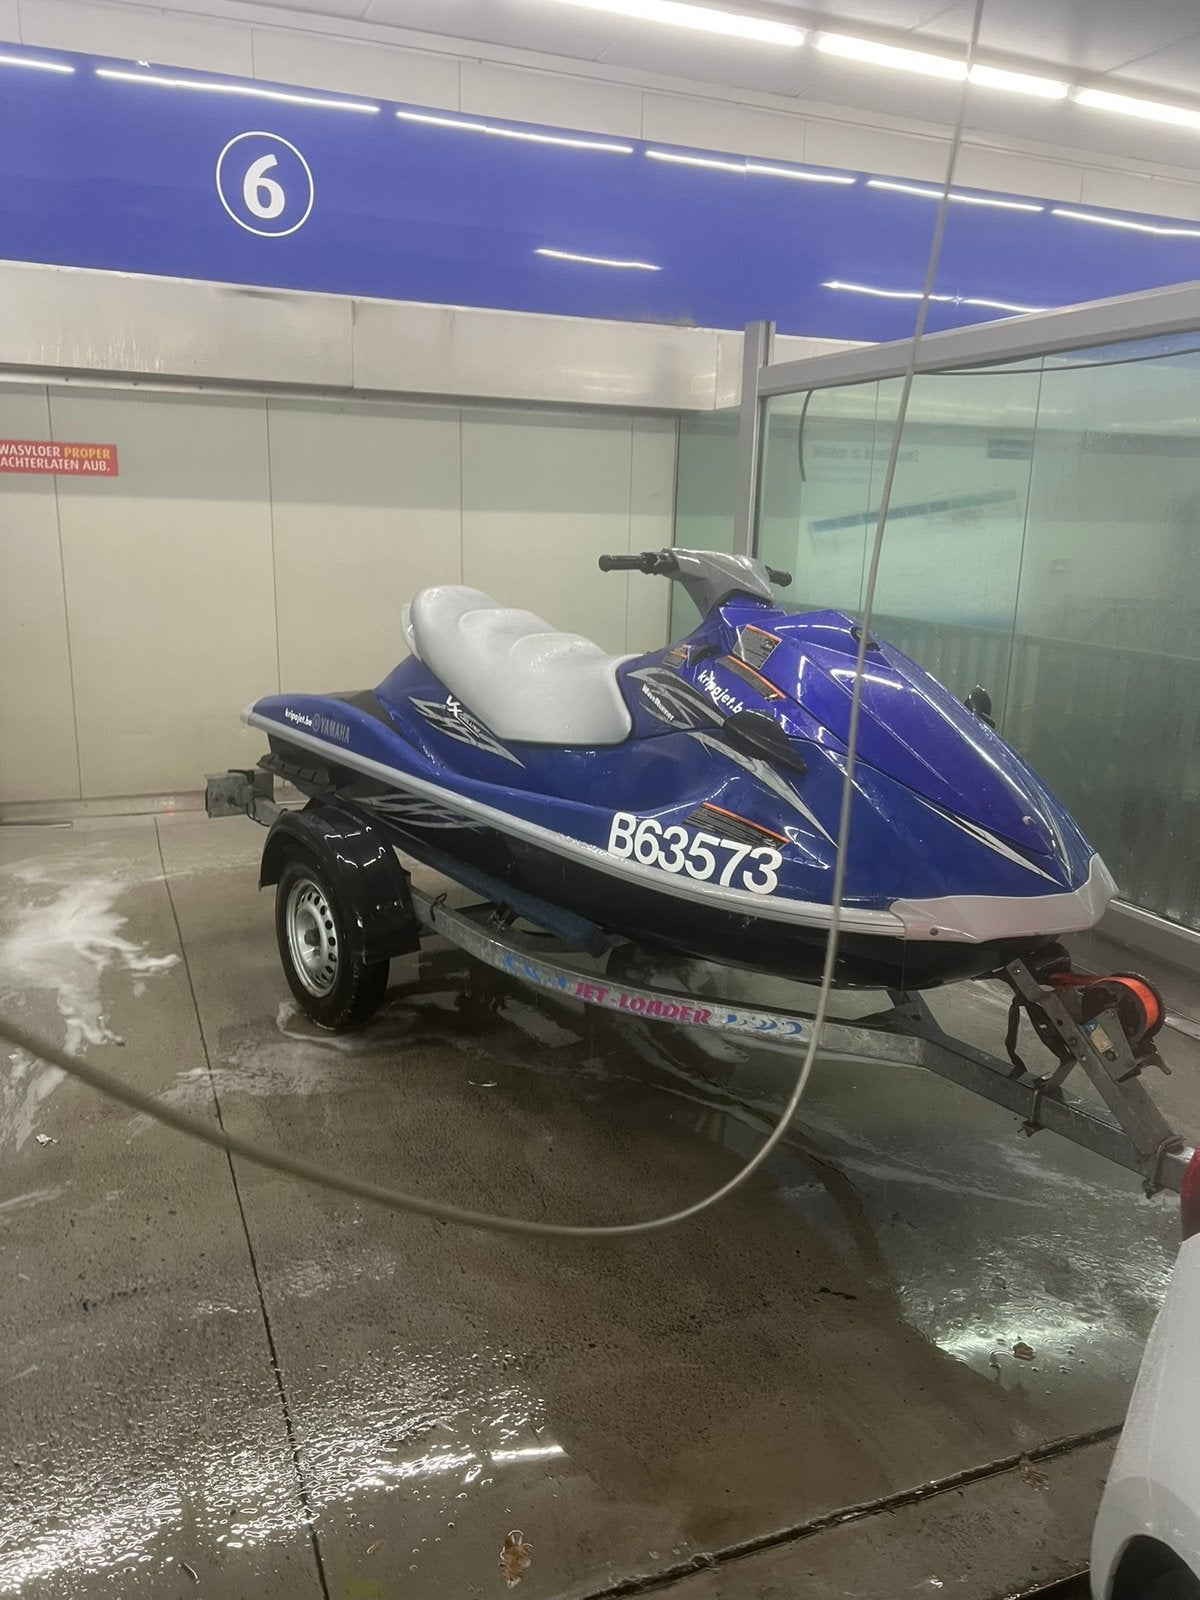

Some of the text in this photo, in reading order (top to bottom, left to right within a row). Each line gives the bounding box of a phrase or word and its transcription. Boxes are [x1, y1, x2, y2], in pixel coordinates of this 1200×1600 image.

[243, 153, 286, 219] 6
[0, 444, 110, 459] WASVLOER PROPER
[0, 456, 110, 471] ACHTERLATEN AUB.
[698, 669, 743, 714] kripajet.b
[320, 716, 350, 744] YAMAHA
[608, 811, 783, 895] B63573
[575, 981, 608, 1001] JET
[619, 993, 713, 1025] LOADER
